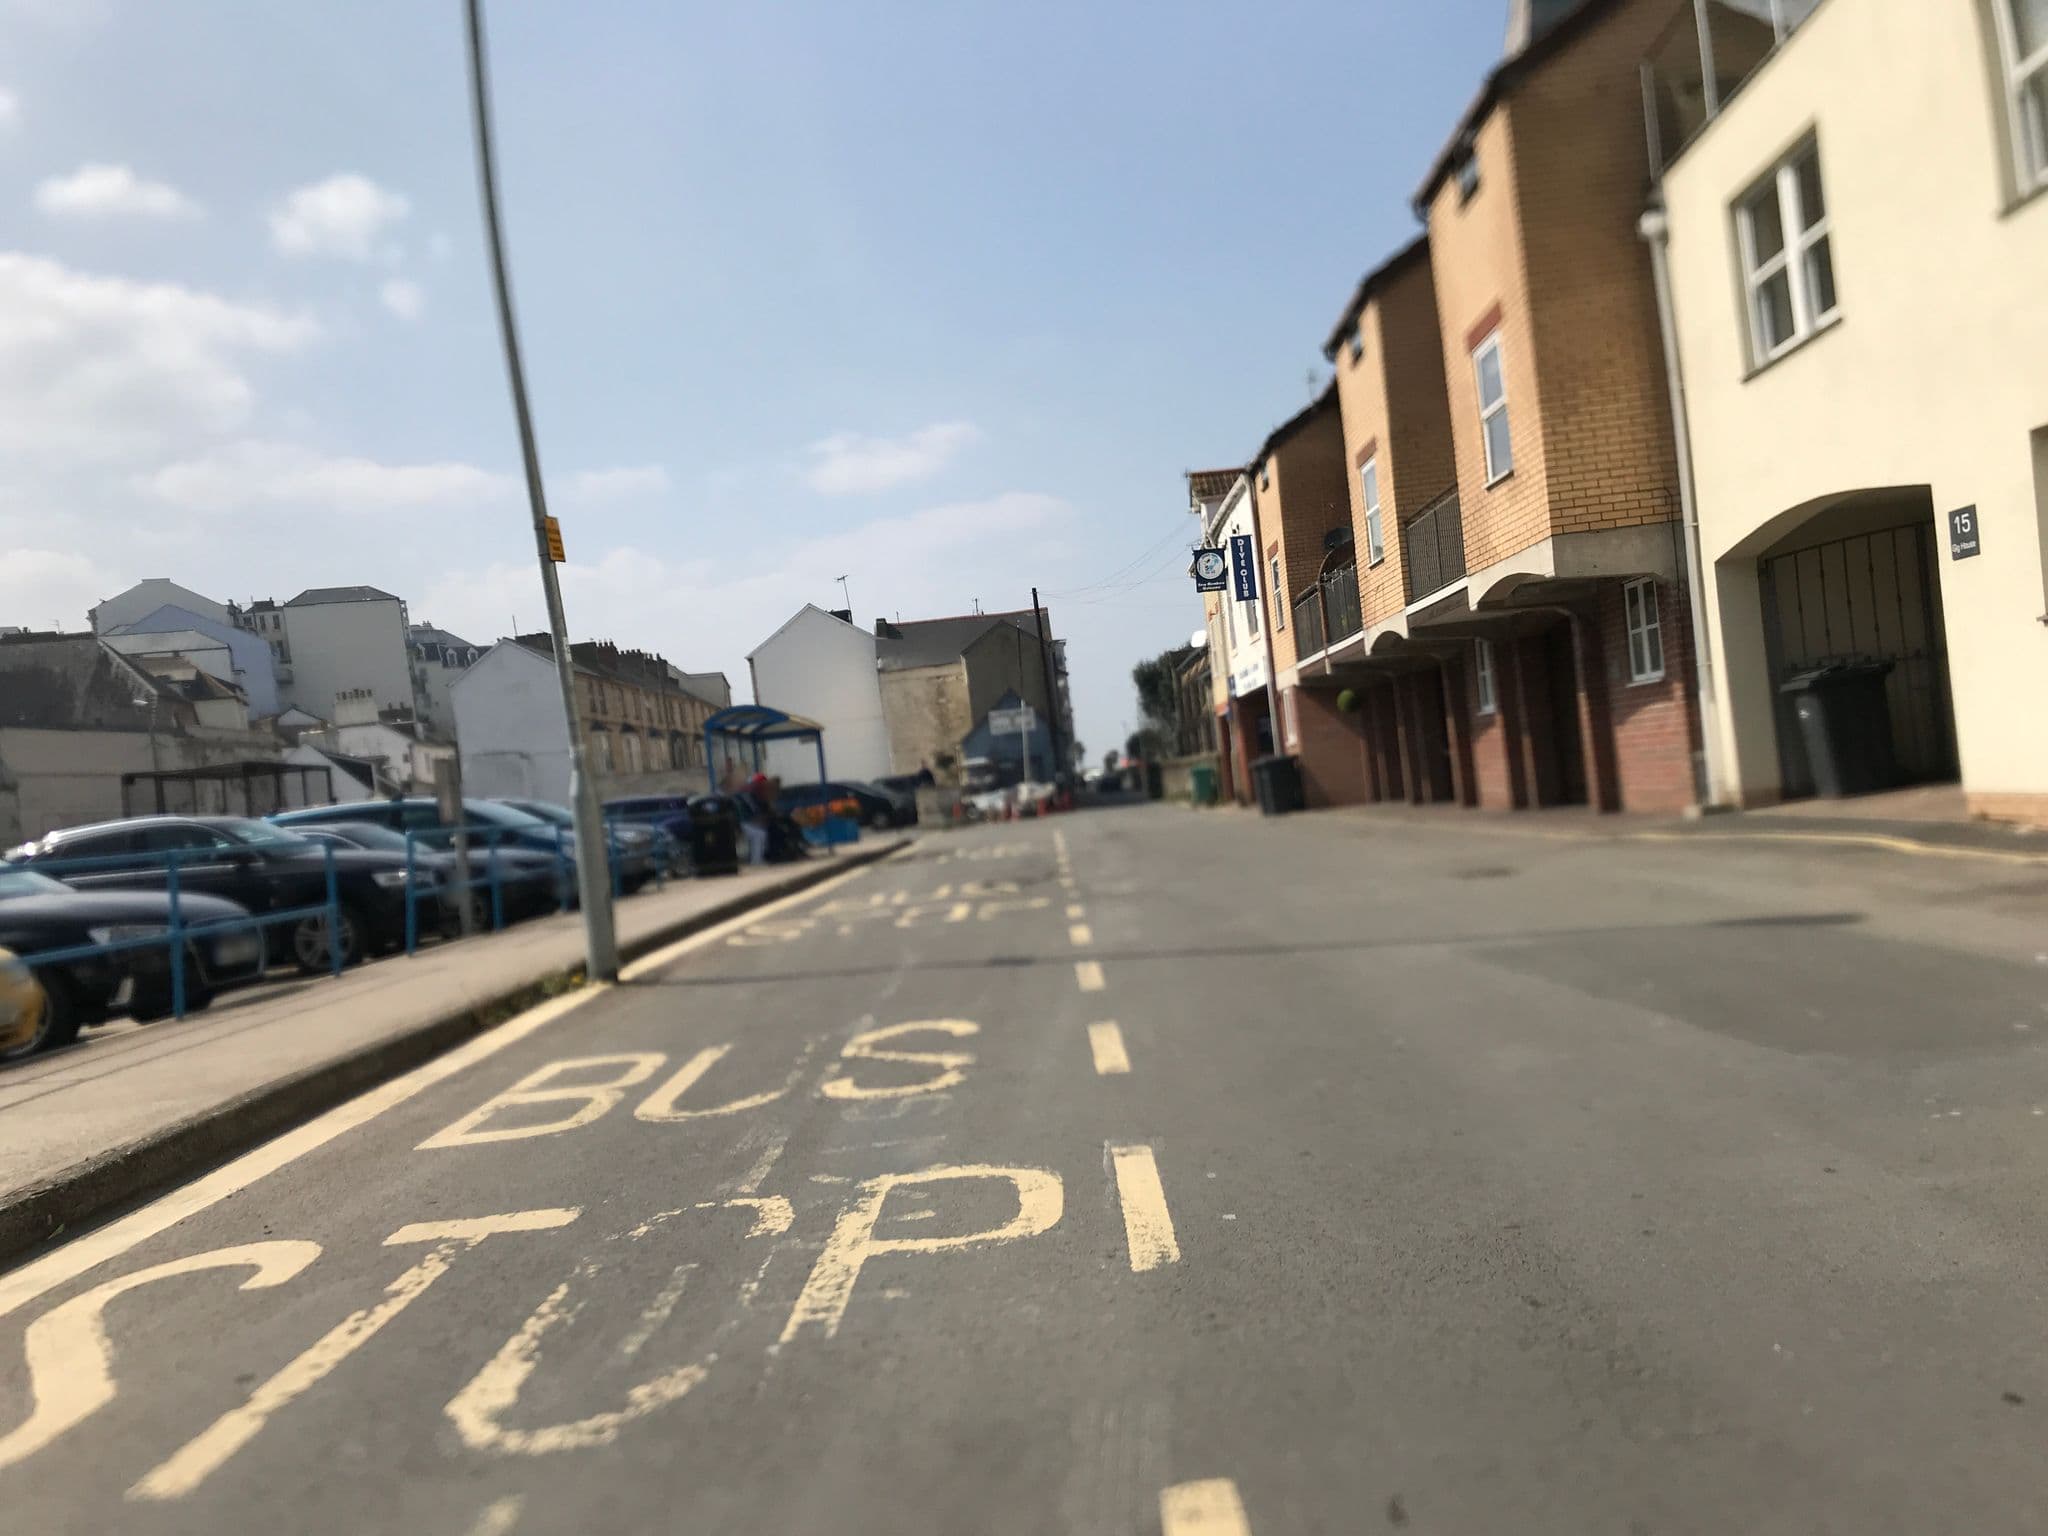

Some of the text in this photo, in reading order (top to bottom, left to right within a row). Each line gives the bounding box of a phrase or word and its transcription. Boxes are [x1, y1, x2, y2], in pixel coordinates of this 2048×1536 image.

[1237, 538, 1249, 597] DIVE CLUB
[1953, 513, 1971, 534] 15
[413, 1018, 980, 1150] BUS
[0, 1162, 1064, 1500] STOP
